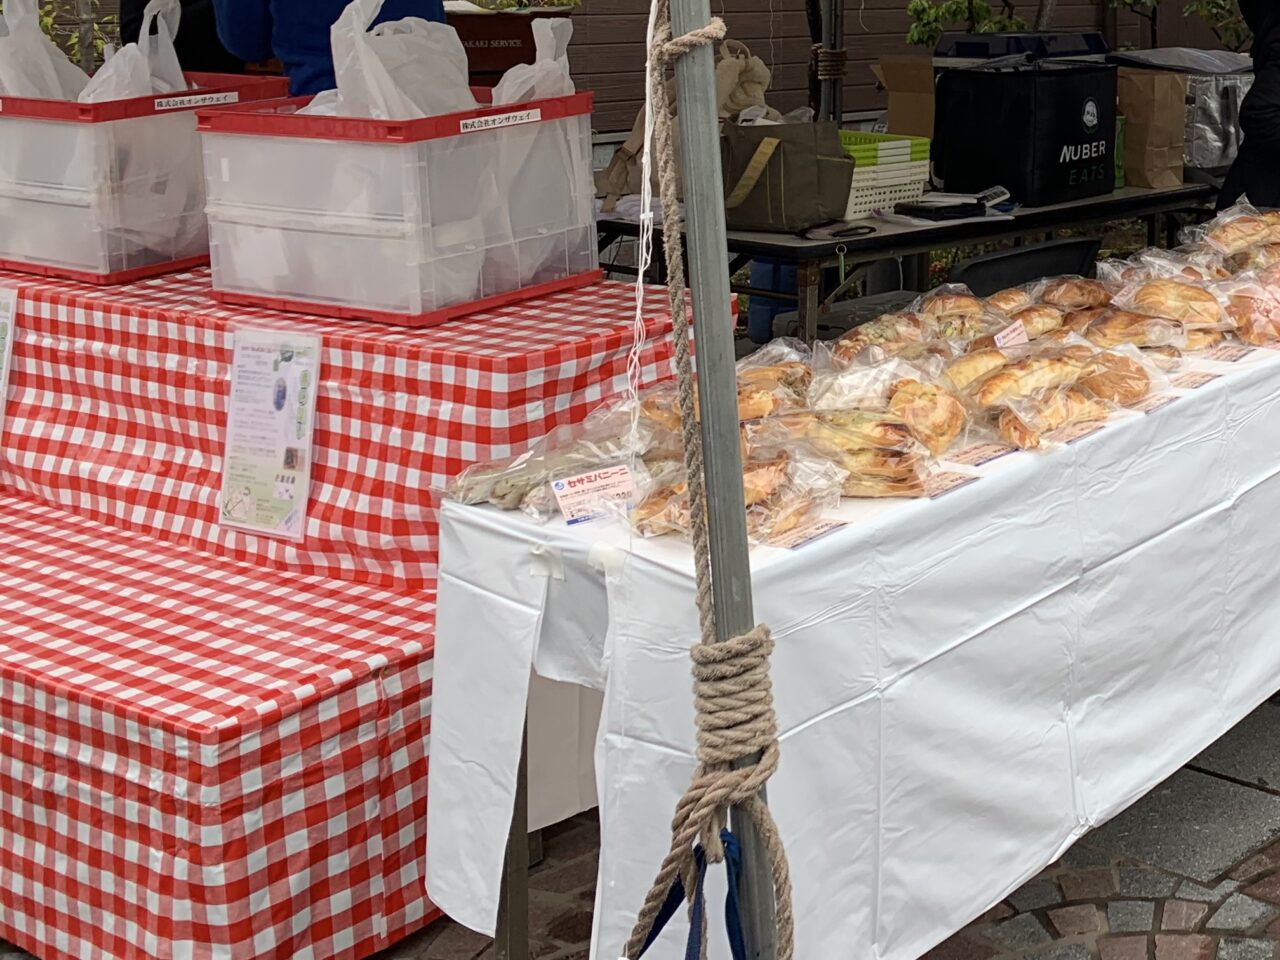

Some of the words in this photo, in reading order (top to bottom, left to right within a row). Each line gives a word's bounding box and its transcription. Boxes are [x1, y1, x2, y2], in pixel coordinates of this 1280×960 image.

[490, 39, 522, 48] SERVICE
[462, 111, 531, 131] 株式会社オンザウェイ
[1059, 140, 1106, 163] NUBER
[1069, 163, 1105, 185] EATS
